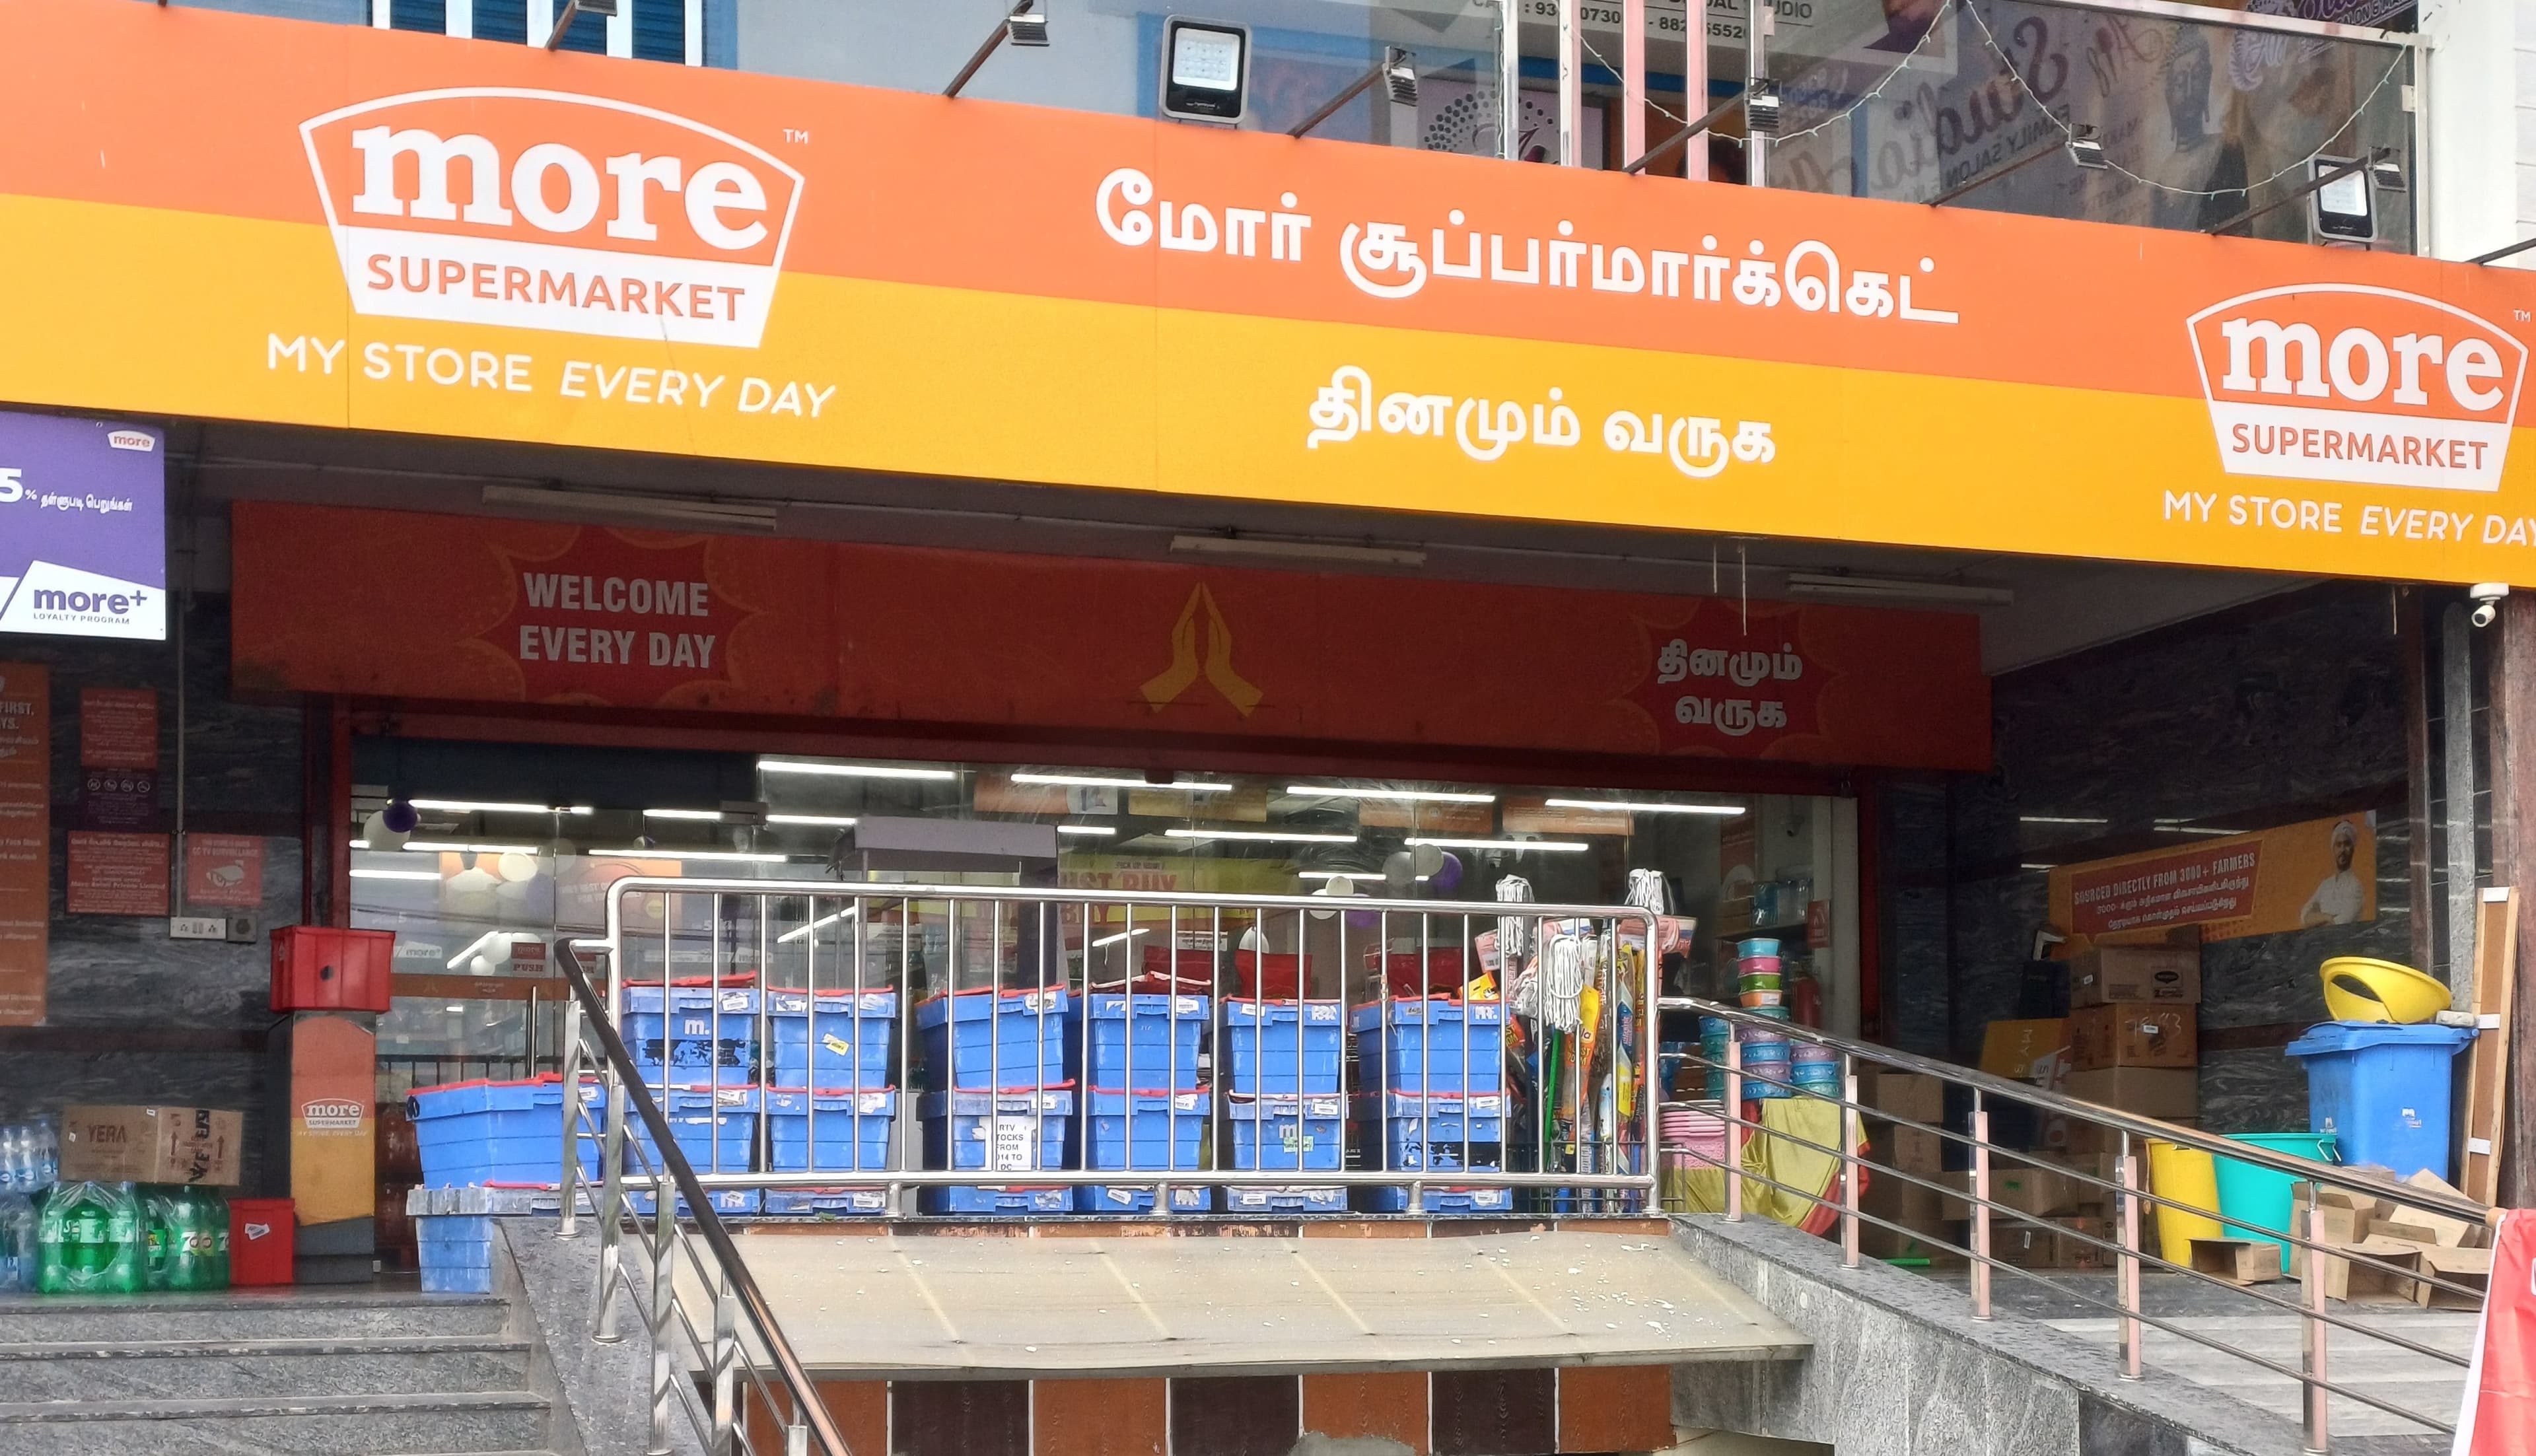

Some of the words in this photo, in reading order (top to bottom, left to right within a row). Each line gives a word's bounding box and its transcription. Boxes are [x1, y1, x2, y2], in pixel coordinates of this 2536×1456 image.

[783, 128, 810, 145] TM
[351, 124, 768, 251] more
[1095, 166, 1312, 262] மோர்
[1339, 208, 1959, 326] சூப்பர்மார்க்கெட்
[367, 252, 746, 322] SUPERMARKET
[2513, 309, 2531, 322] TM
[267, 332, 345, 374] MY
[363, 343, 533, 393] STORE
[560, 360, 726, 409] EVERY
[737, 377, 837, 419] DAY
[2221, 317, 2505, 411] more
[113, 434, 151, 448] more
[1307, 364, 1581, 462] தினமும்
[1604, 409, 1776, 479] வருக
[2232, 423, 2489, 470] SUPERMARKET
[2163, 490, 2217, 522] MY
[2228, 494, 2343, 533] STORE
[2360, 505, 2474, 541] EVERY
[2482, 514, 2536, 547] DAY
[523, 572, 709, 617] WELCOME
[33, 613, 76, 622] LOYALTY
[80, 615, 130, 625] PROGRAM
[519, 625, 635, 665] EVERY
[649, 632, 716, 668] DAY
[1657, 639, 1803, 687] தினமும்
[1675, 695, 1788, 736] வருக
[2074, 884, 2111, 905] SOURCED
[2113, 876, 2151, 897] DIRECTLY
[2153, 872, 2177, 888] FROM
[2212, 852, 2255, 875] FARMERS
[512, 963, 544, 972] PUSH
[306, 1104, 360, 1117] more
